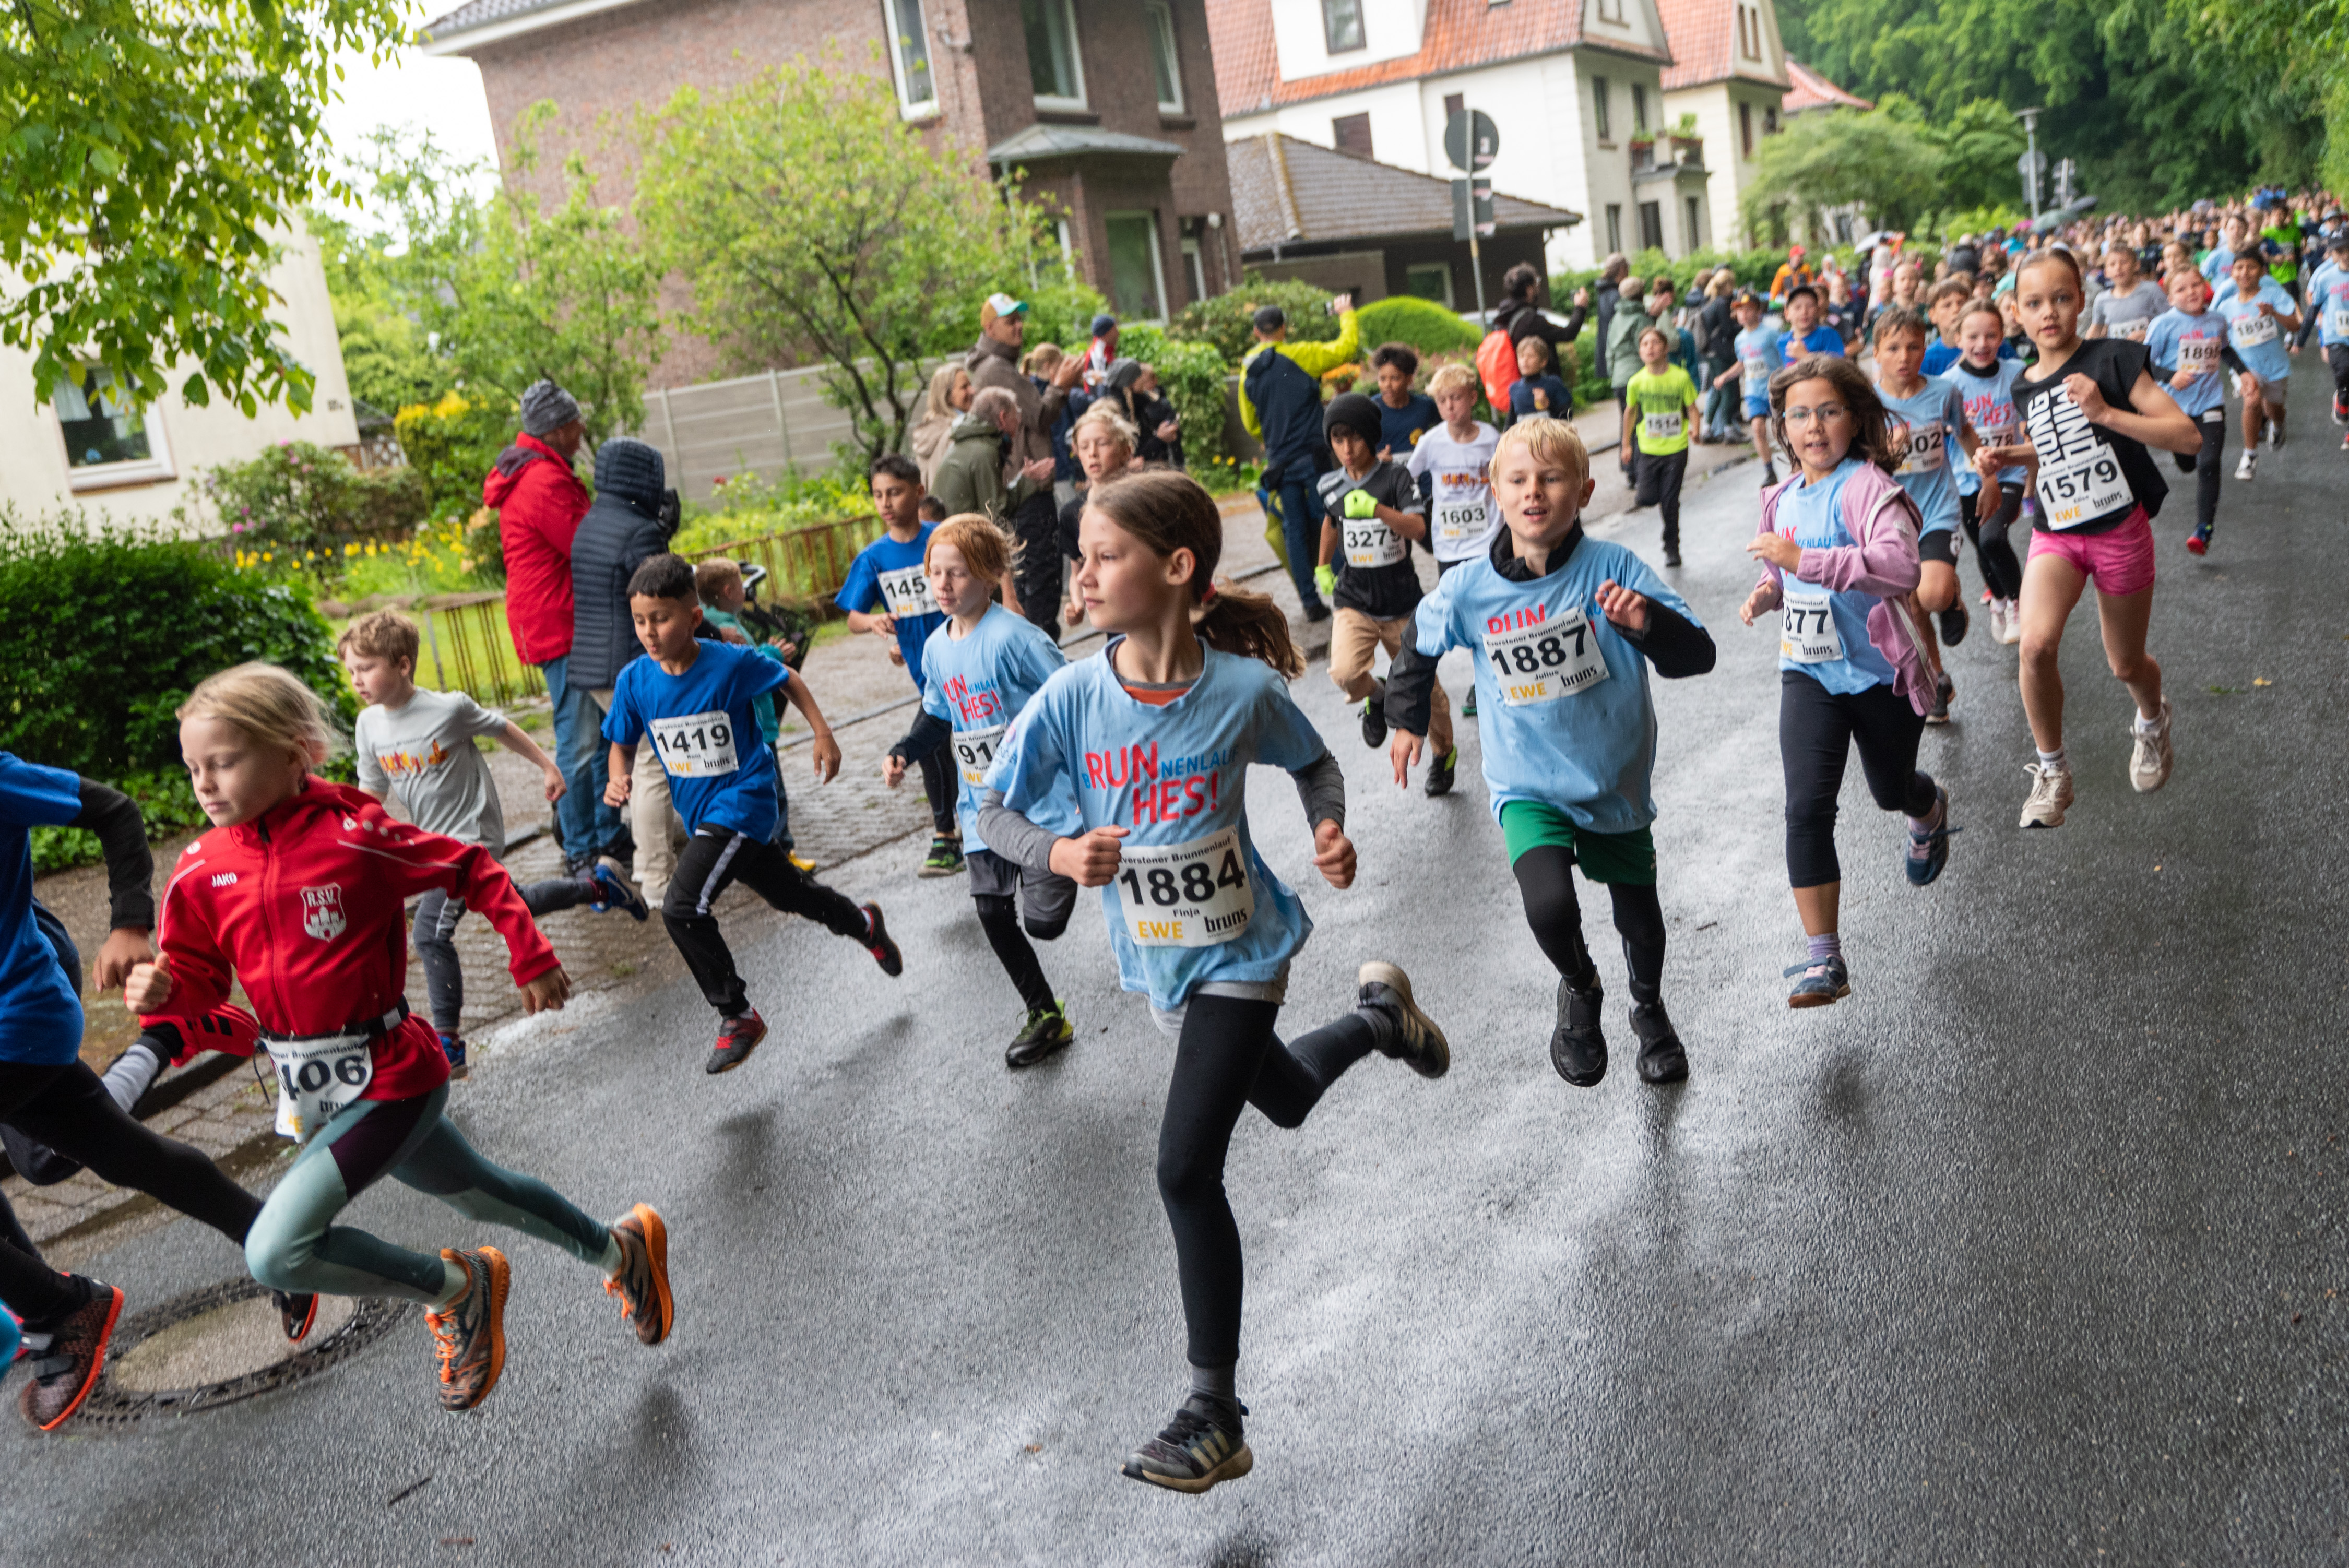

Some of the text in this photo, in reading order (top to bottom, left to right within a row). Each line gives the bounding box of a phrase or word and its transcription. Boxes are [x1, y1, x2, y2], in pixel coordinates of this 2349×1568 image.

[2042, 459, 2118, 503] 1579
[2093, 490, 2122, 508] bruns
[1441, 507, 1485, 524] 1603
[2055, 505, 2082, 522] EWE
[886, 576, 927, 598] 145
[1528, 614, 1579, 640] Brunnenlauf
[1491, 622, 1587, 676] 1887
[1802, 644, 1833, 655] bruns
[1535, 670, 1560, 681] Julius
[1560, 664, 1597, 687] bruns
[1510, 681, 1547, 699] EWE
[959, 690, 1002, 723] HES!
[657, 723, 730, 753] 1419
[669, 761, 693, 773] EWE
[1133, 771, 1218, 826] HES!
[1122, 835, 1231, 865] verstener Brunnenlauf
[211, 872, 238, 888] JAKO
[1120, 848, 1245, 906] 1884
[307, 887, 337, 907] R.S.V.
[1172, 907, 1201, 918] Finja
[1204, 908, 1248, 933] bruns
[1137, 920, 1183, 940] EWE
